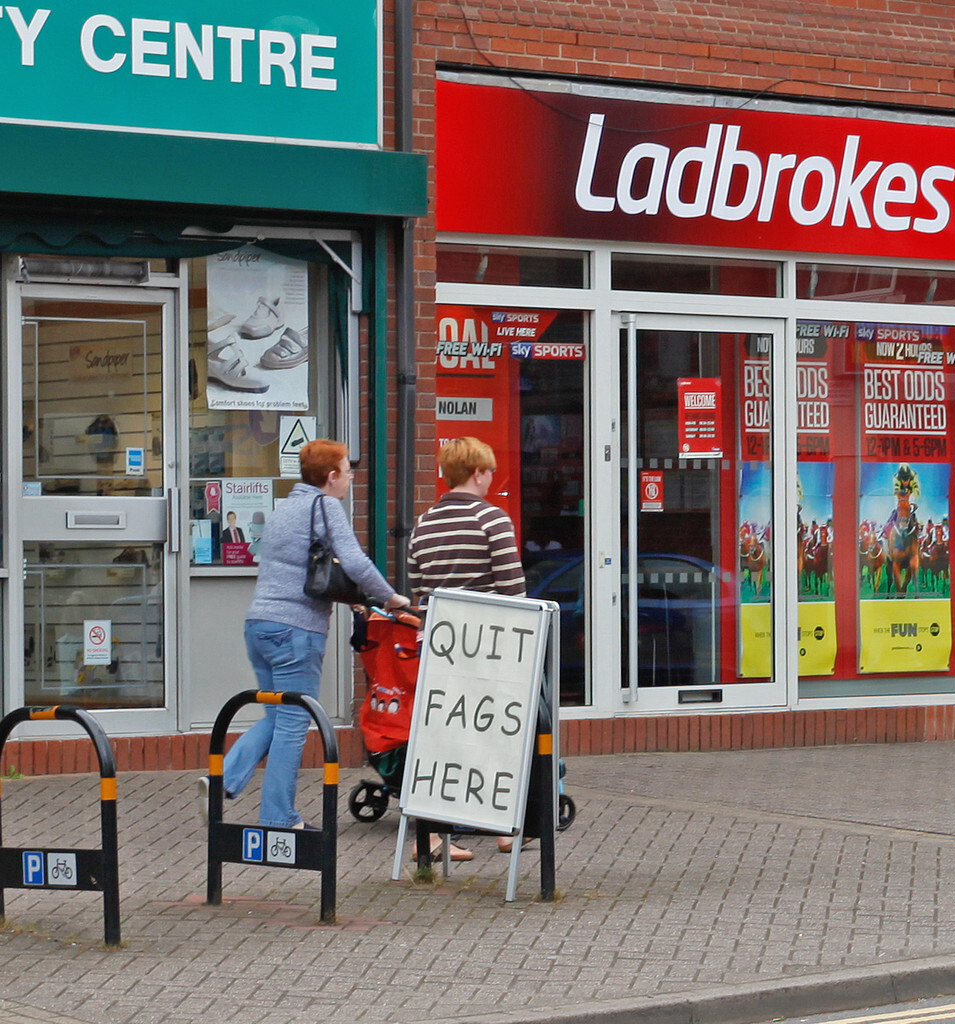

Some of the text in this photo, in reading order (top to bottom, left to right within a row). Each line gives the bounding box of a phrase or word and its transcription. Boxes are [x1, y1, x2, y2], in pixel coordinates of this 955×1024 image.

[0, 5, 337, 91] Y CENTRE
[575, 113, 955, 234] Ladbrokes
[507, 314, 539, 323] SPORTS
[496, 327, 536, 337] LIVE HERE
[857, 328, 920, 341] sky SPORTS
[436, 341, 468, 356] FREE
[511, 344, 583, 358] sky SPORTS
[876, 341, 895, 357] NOW
[895, 342, 904, 360] 2
[917, 350, 944, 365] FREE
[864, 368, 945, 401] BEST ODDS
[210, 399, 236, 407] Comfort
[266, 399, 291, 408] problem
[438, 400, 477, 415] NOLAN
[684, 393, 716, 407] WELCOME
[864, 402, 947, 430] GUARANTEED
[866, 436, 946, 457] 12-1PM & 5-6PM
[225, 481, 269, 494] Stairlifts
[890, 623, 918, 638] FUN
[429, 620, 534, 665] QUIT
[425, 689, 522, 736] FAGS
[411, 758, 514, 811] HERE
[247, 831, 260, 858] P
[27, 855, 40, 882] P
